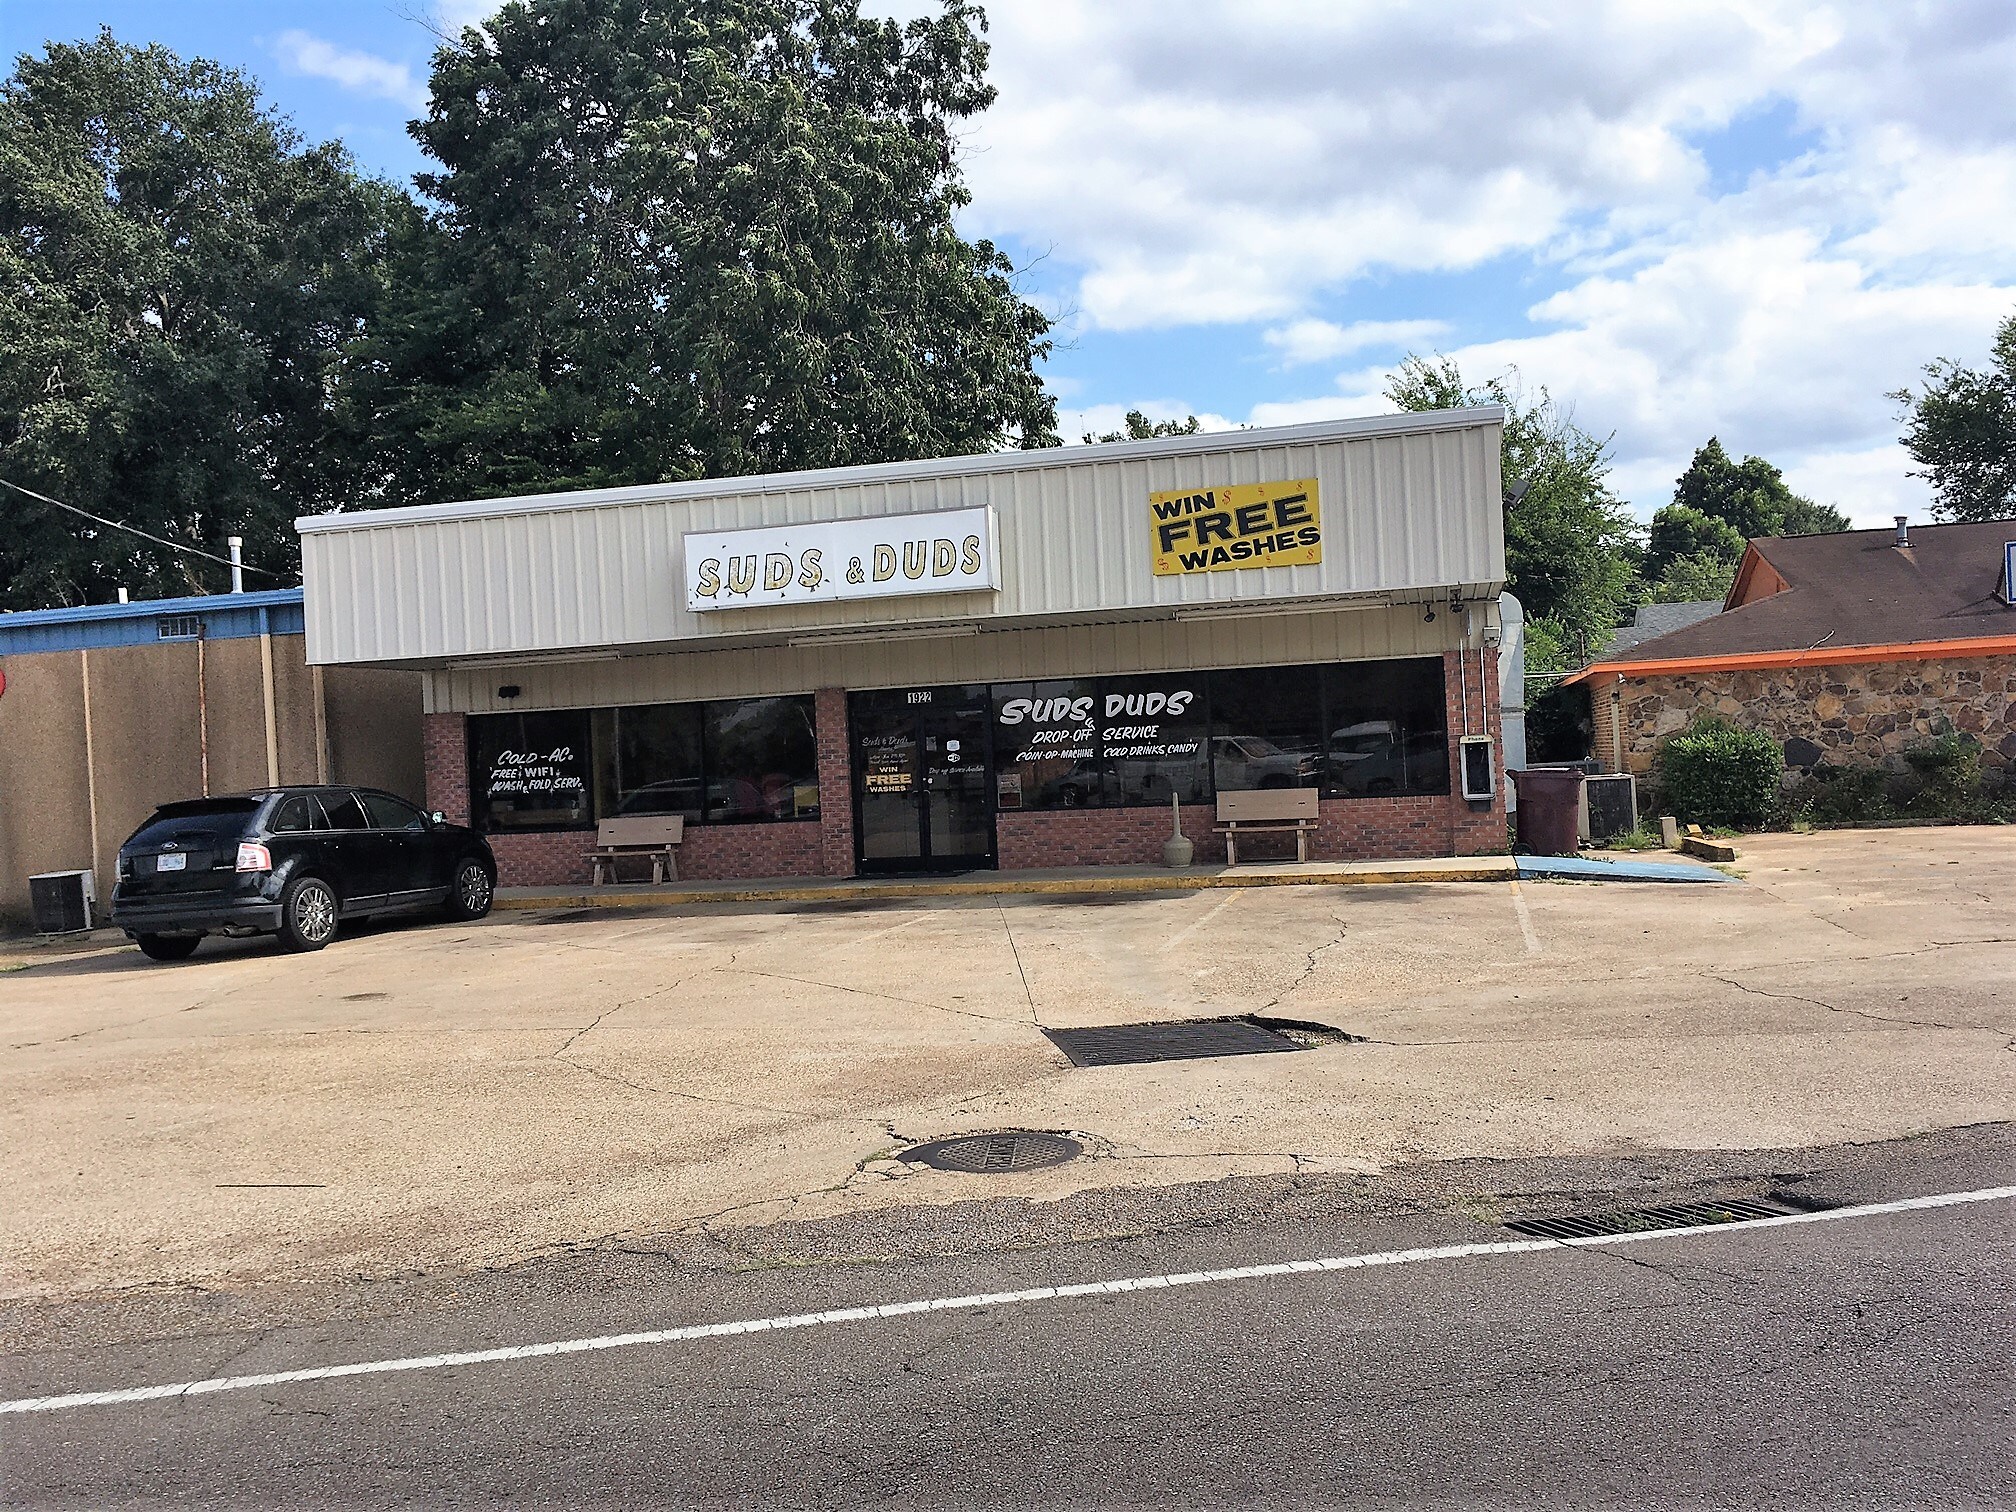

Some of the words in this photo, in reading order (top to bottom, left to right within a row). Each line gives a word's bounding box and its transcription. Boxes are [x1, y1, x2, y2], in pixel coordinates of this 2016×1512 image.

[1153, 491, 1216, 520] WIN
[1157, 493, 1314, 554] FREE
[1179, 526, 1321, 571] WASHES
[696, 548, 823, 597] SUDS
[846, 556, 865, 584] &
[872, 535, 981, 582] DUDS
[908, 691, 931, 703] 1922
[1000, 697, 1094, 725] SUDS
[1105, 690, 1194, 718] DUDS
[1032, 728, 1093, 744] DROP-OFF
[1102, 725, 1160, 741] SERVICE
[1104, 747, 1128, 757] COLD
[1129, 745, 1166, 756] DRINKS
[1167, 743, 1198, 753] CANDY
[490, 769, 517, 779] FREE
[524, 767, 554, 778] WIFI
[866, 773, 912, 786] FREE
[492, 780, 523, 792] WASH
[529, 779, 551, 790] FOLD
[870, 785, 906, 793] WASHES
